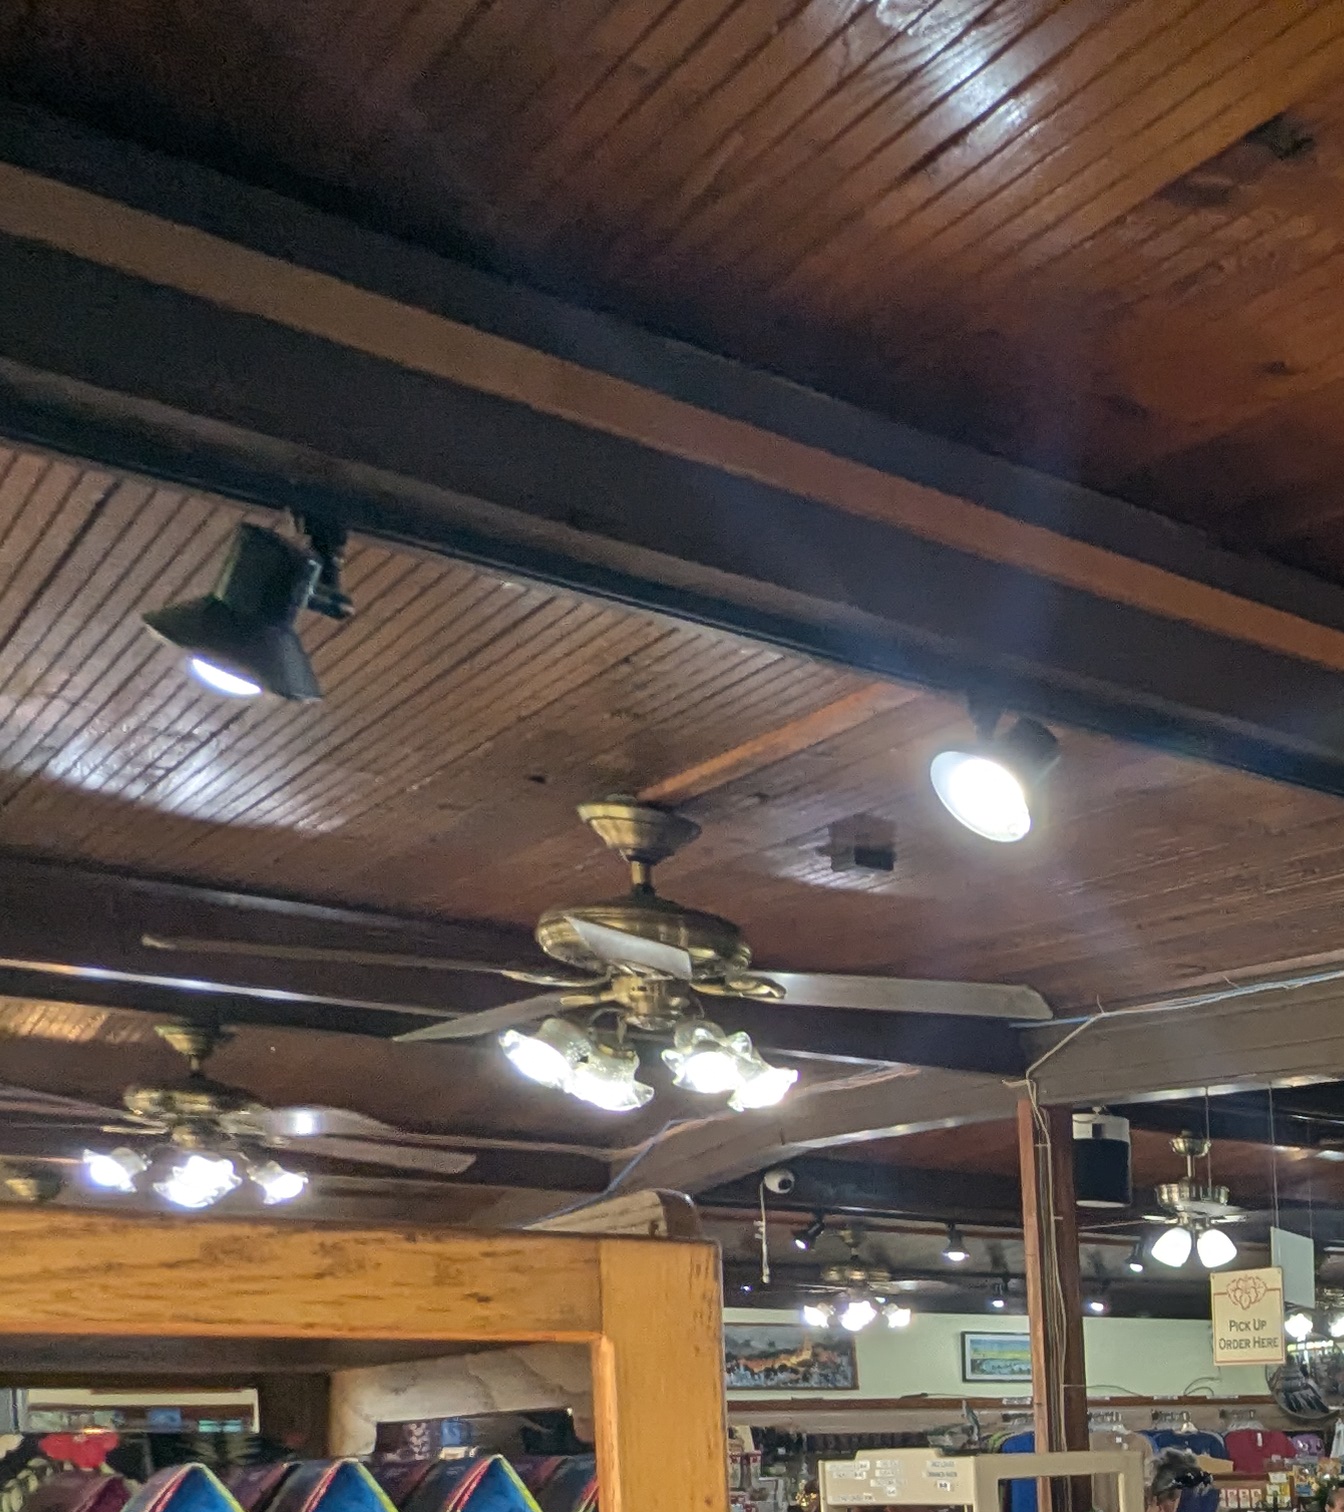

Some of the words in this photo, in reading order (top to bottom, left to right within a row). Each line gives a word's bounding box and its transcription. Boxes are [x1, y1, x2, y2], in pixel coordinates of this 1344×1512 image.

[1228, 1320, 1251, 1332] PICK
[1252, 1318, 1267, 1331] UP
[1218, 1337, 1251, 1350] ORDER
[1253, 1336, 1279, 1349] HERE
